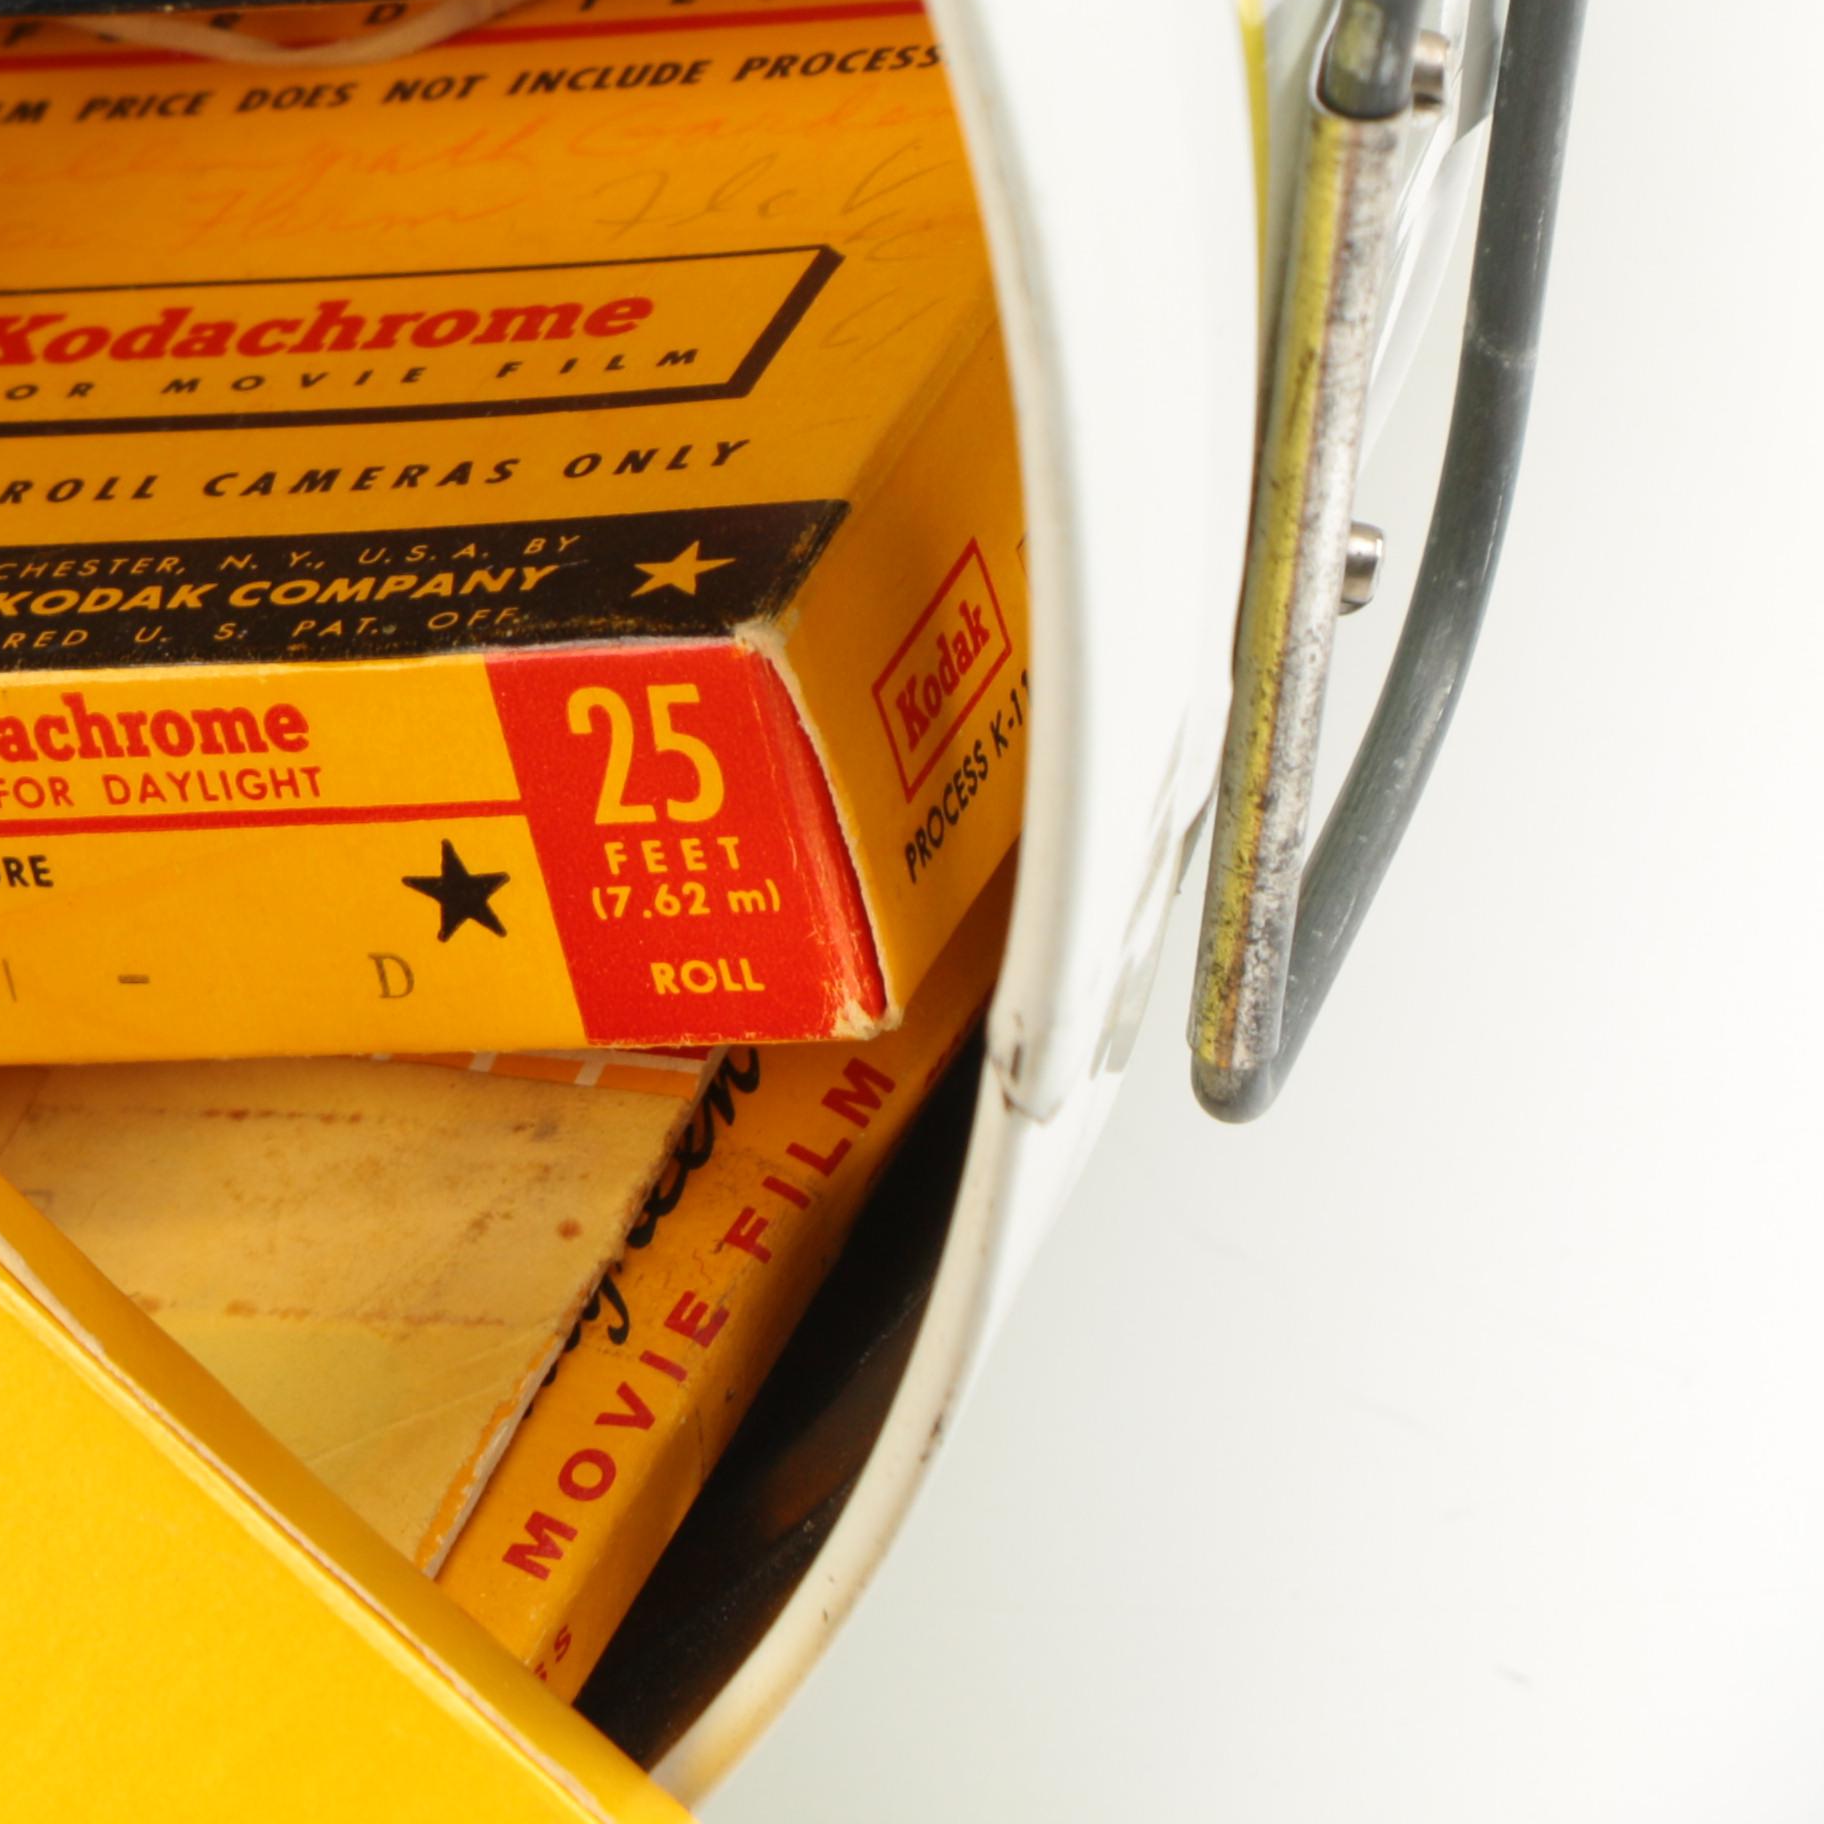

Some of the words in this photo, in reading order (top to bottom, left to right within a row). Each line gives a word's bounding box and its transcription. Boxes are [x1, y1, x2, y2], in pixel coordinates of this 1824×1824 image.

[76, 91, 209, 121] PRICE
[236, 83, 354, 113] DOES
[383, 74, 485, 102] NOT
[507, 60, 710, 96] INCLUDE
[733, 41, 952, 81] PROCESS
[160, 366, 425, 394] MOVIE
[495, 348, 698, 379] FILM
[202, 458, 520, 497] CAMERAS
[562, 440, 749, 479] ONLY
[219, 554, 257, 570] N.
[522, 535, 580, 555] BY
[228, 564, 558, 607] COMPANY
[133, 625, 167, 644] U.
[291, 616, 378, 638] PAT.
[426, 607, 522, 632] OFF.
[895, 600, 990, 753] Kodak
[566, 683, 725, 825] 25
[101, 765, 321, 805] DAYLIGHT
[904, 738, 989, 884] PROCESS
[604, 836, 740, 876] FEET
[591, 881, 711, 920] (7.62
[727, 878, 781, 913] m)
[369, 954, 416, 1000] D
[650, 958, 765, 995] ROLL
[504, 1289, 731, 1580] MOVIE
[723, 1057, 897, 1264] FILM
